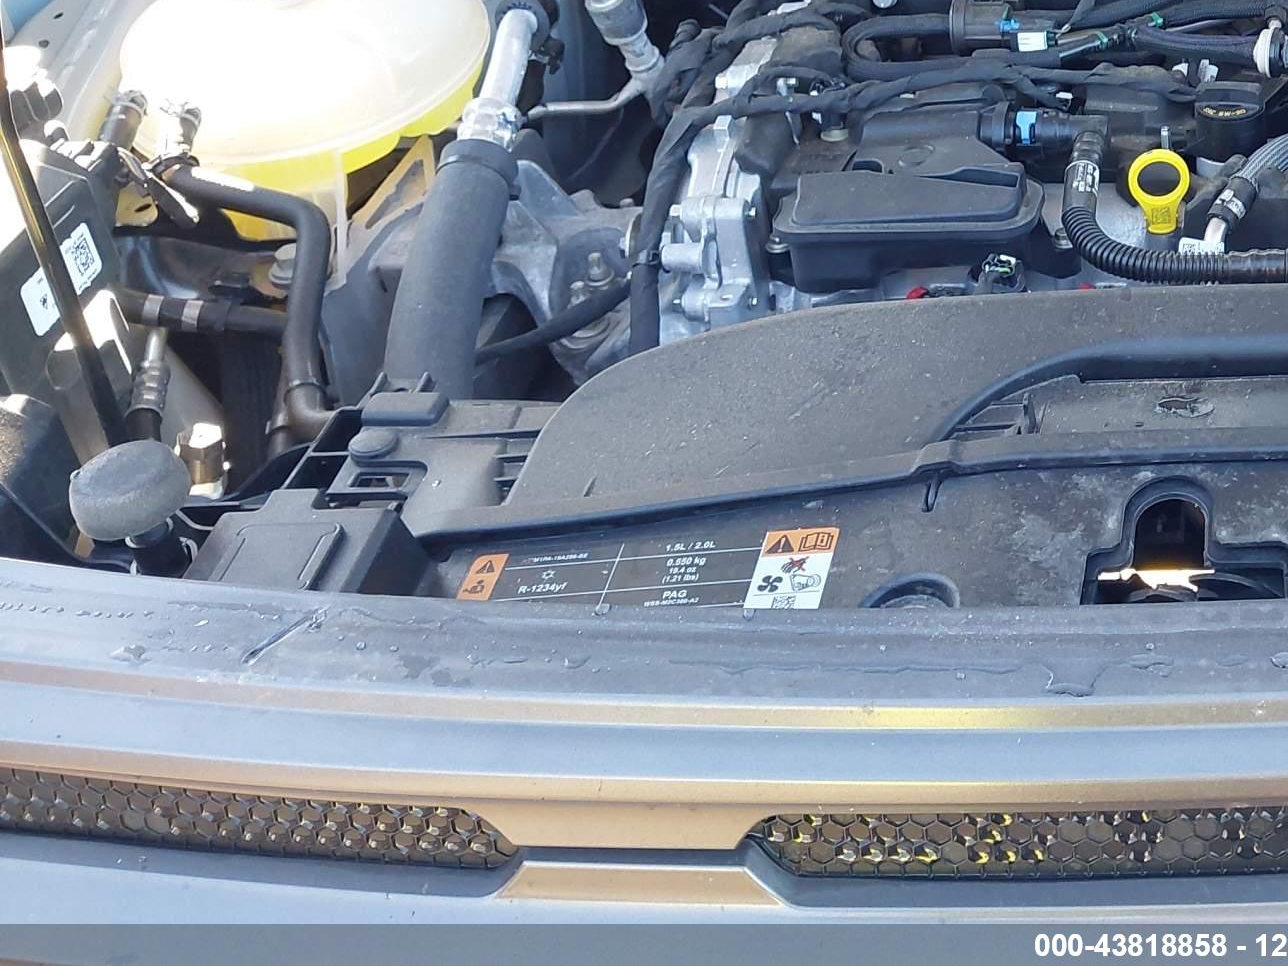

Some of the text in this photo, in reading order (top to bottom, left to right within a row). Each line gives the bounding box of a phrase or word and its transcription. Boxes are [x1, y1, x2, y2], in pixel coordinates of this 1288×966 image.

[694, 540, 716, 550] 2.0L
[666, 555, 707, 567] 0.550 kg
[517, 581, 568, 594] R-1234yf
[662, 589, 688, 600] PAG
